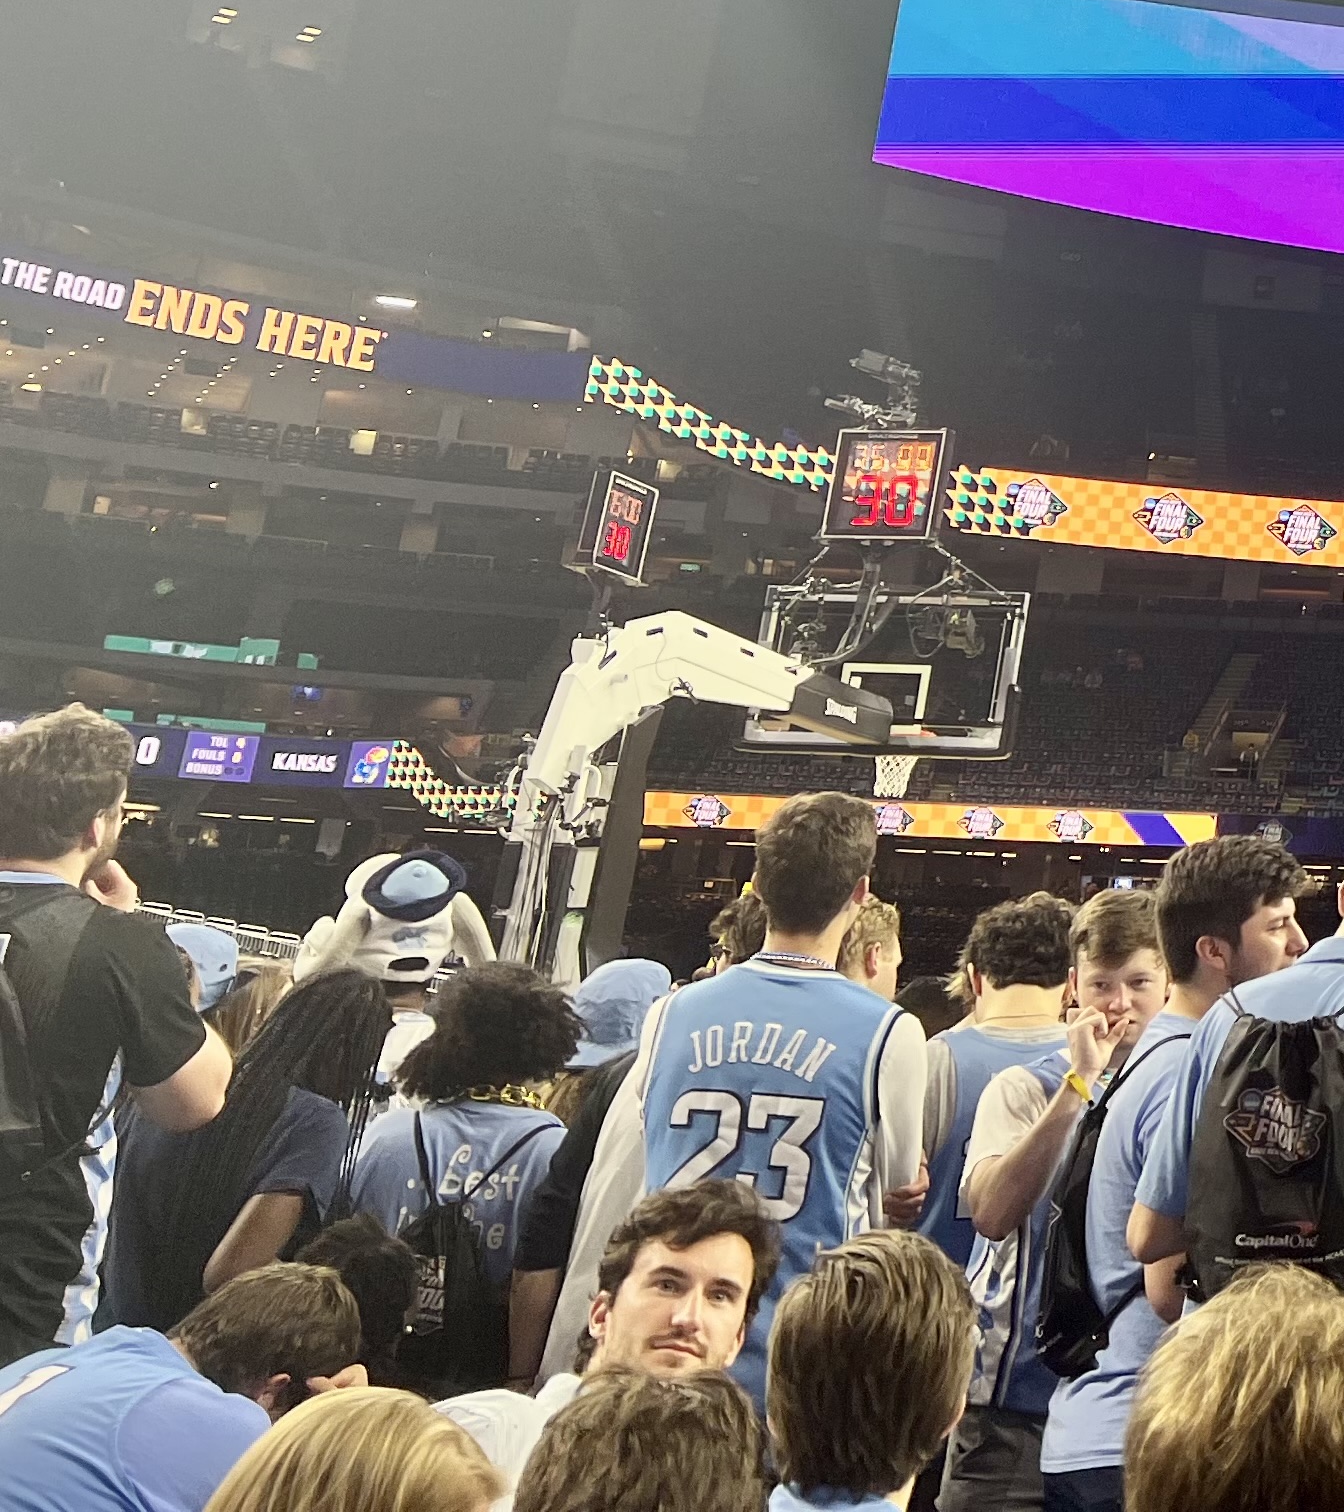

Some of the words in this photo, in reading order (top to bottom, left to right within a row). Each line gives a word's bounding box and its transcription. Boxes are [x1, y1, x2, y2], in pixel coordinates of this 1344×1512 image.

[1, 257, 50, 295] THE
[53, 270, 126, 310] ROAD
[124, 279, 250, 345] ENDS
[256, 307, 381, 372] HERE
[850, 475, 918, 526] 30
[1017, 487, 1051, 505] FINAL
[1014, 502, 1046, 518] FOUR
[1153, 501, 1188, 519] FINAL
[1150, 516, 1184, 532] FOUR
[1288, 514, 1321, 530] FINAL
[602, 520, 631, 560] 30
[1284, 528, 1318, 545] FOUR
[136, 736, 161, 765] 0
[210, 737, 228, 748] TOL
[191, 749, 226, 761] FOULS
[272, 752, 338, 773] KANSAS
[185, 763, 223, 775] BONUS
[688, 1021, 836, 1082] JORDAN
[665, 1089, 825, 1223] 23
